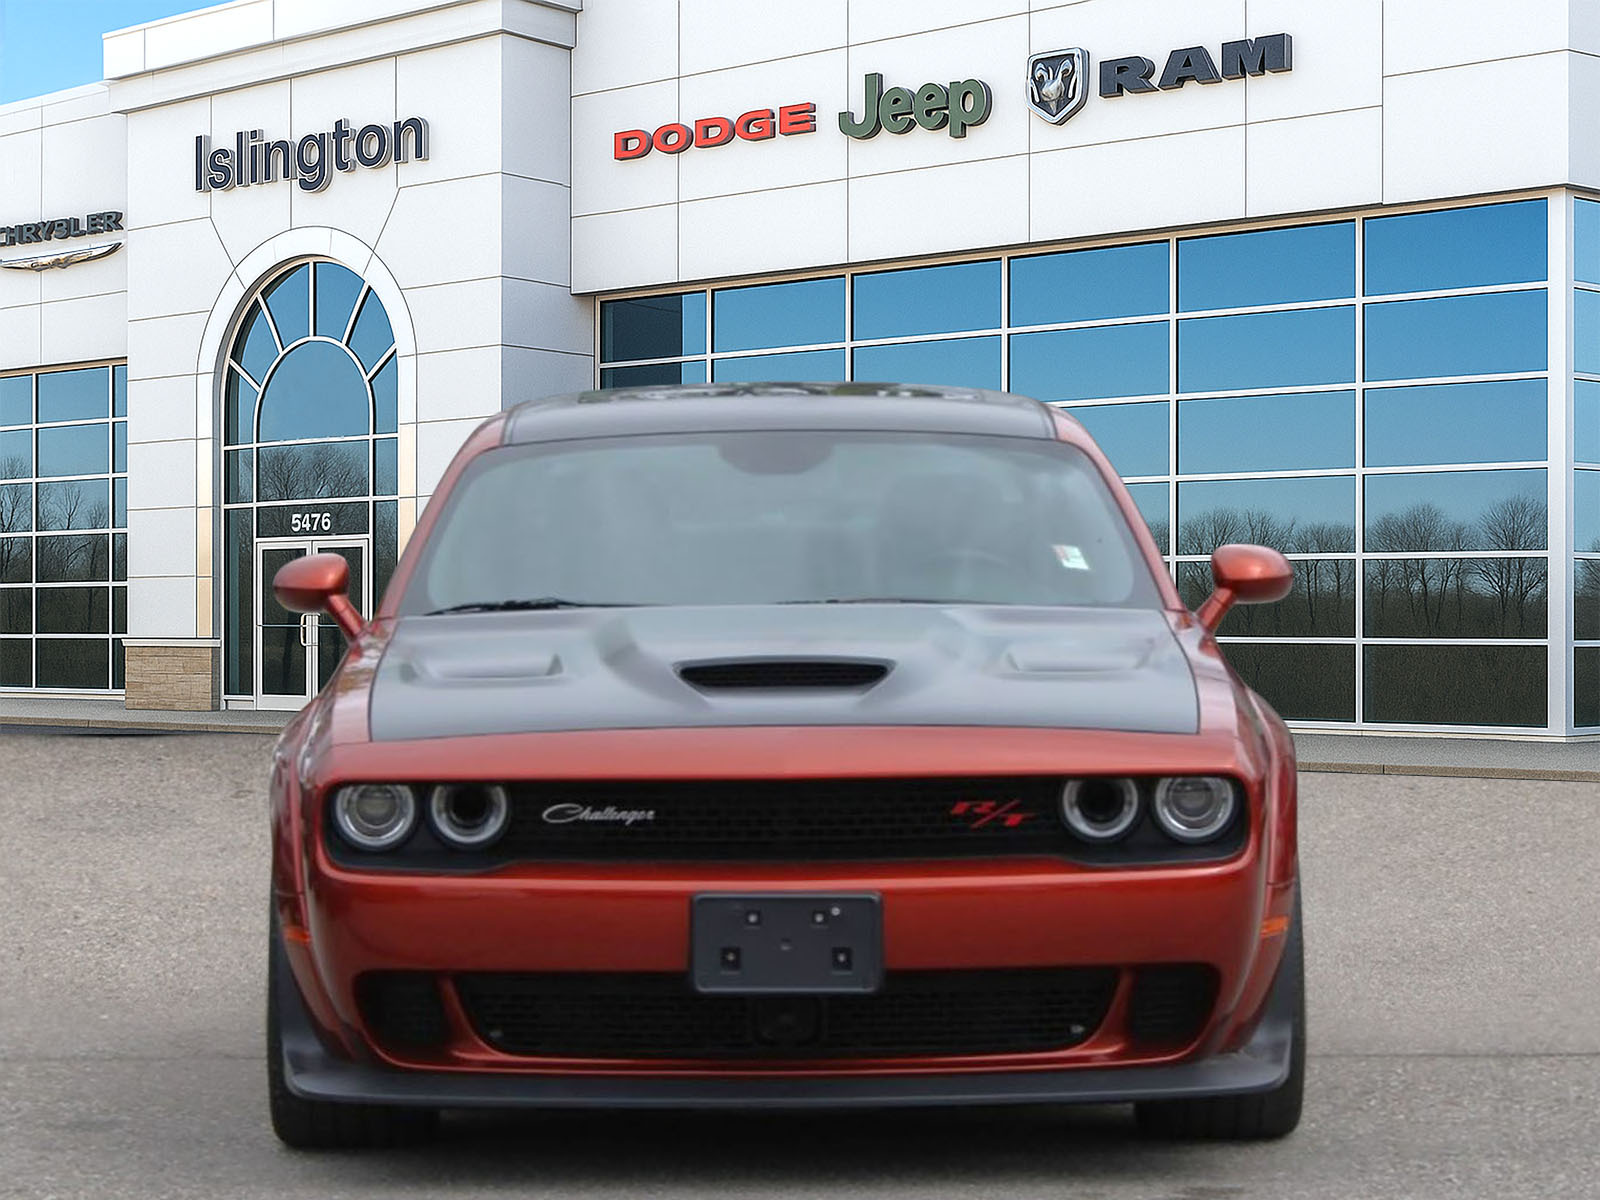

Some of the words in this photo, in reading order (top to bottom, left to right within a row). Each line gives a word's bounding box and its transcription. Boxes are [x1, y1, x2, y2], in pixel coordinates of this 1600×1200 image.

[613, 102, 816, 159] DODGE
[839, 73, 991, 140] Jeep
[1101, 33, 1292, 97] RAM
[195, 116, 429, 193] Islington
[291, 512, 331, 532] 5476
[541, 803, 656, 826] Challenger
